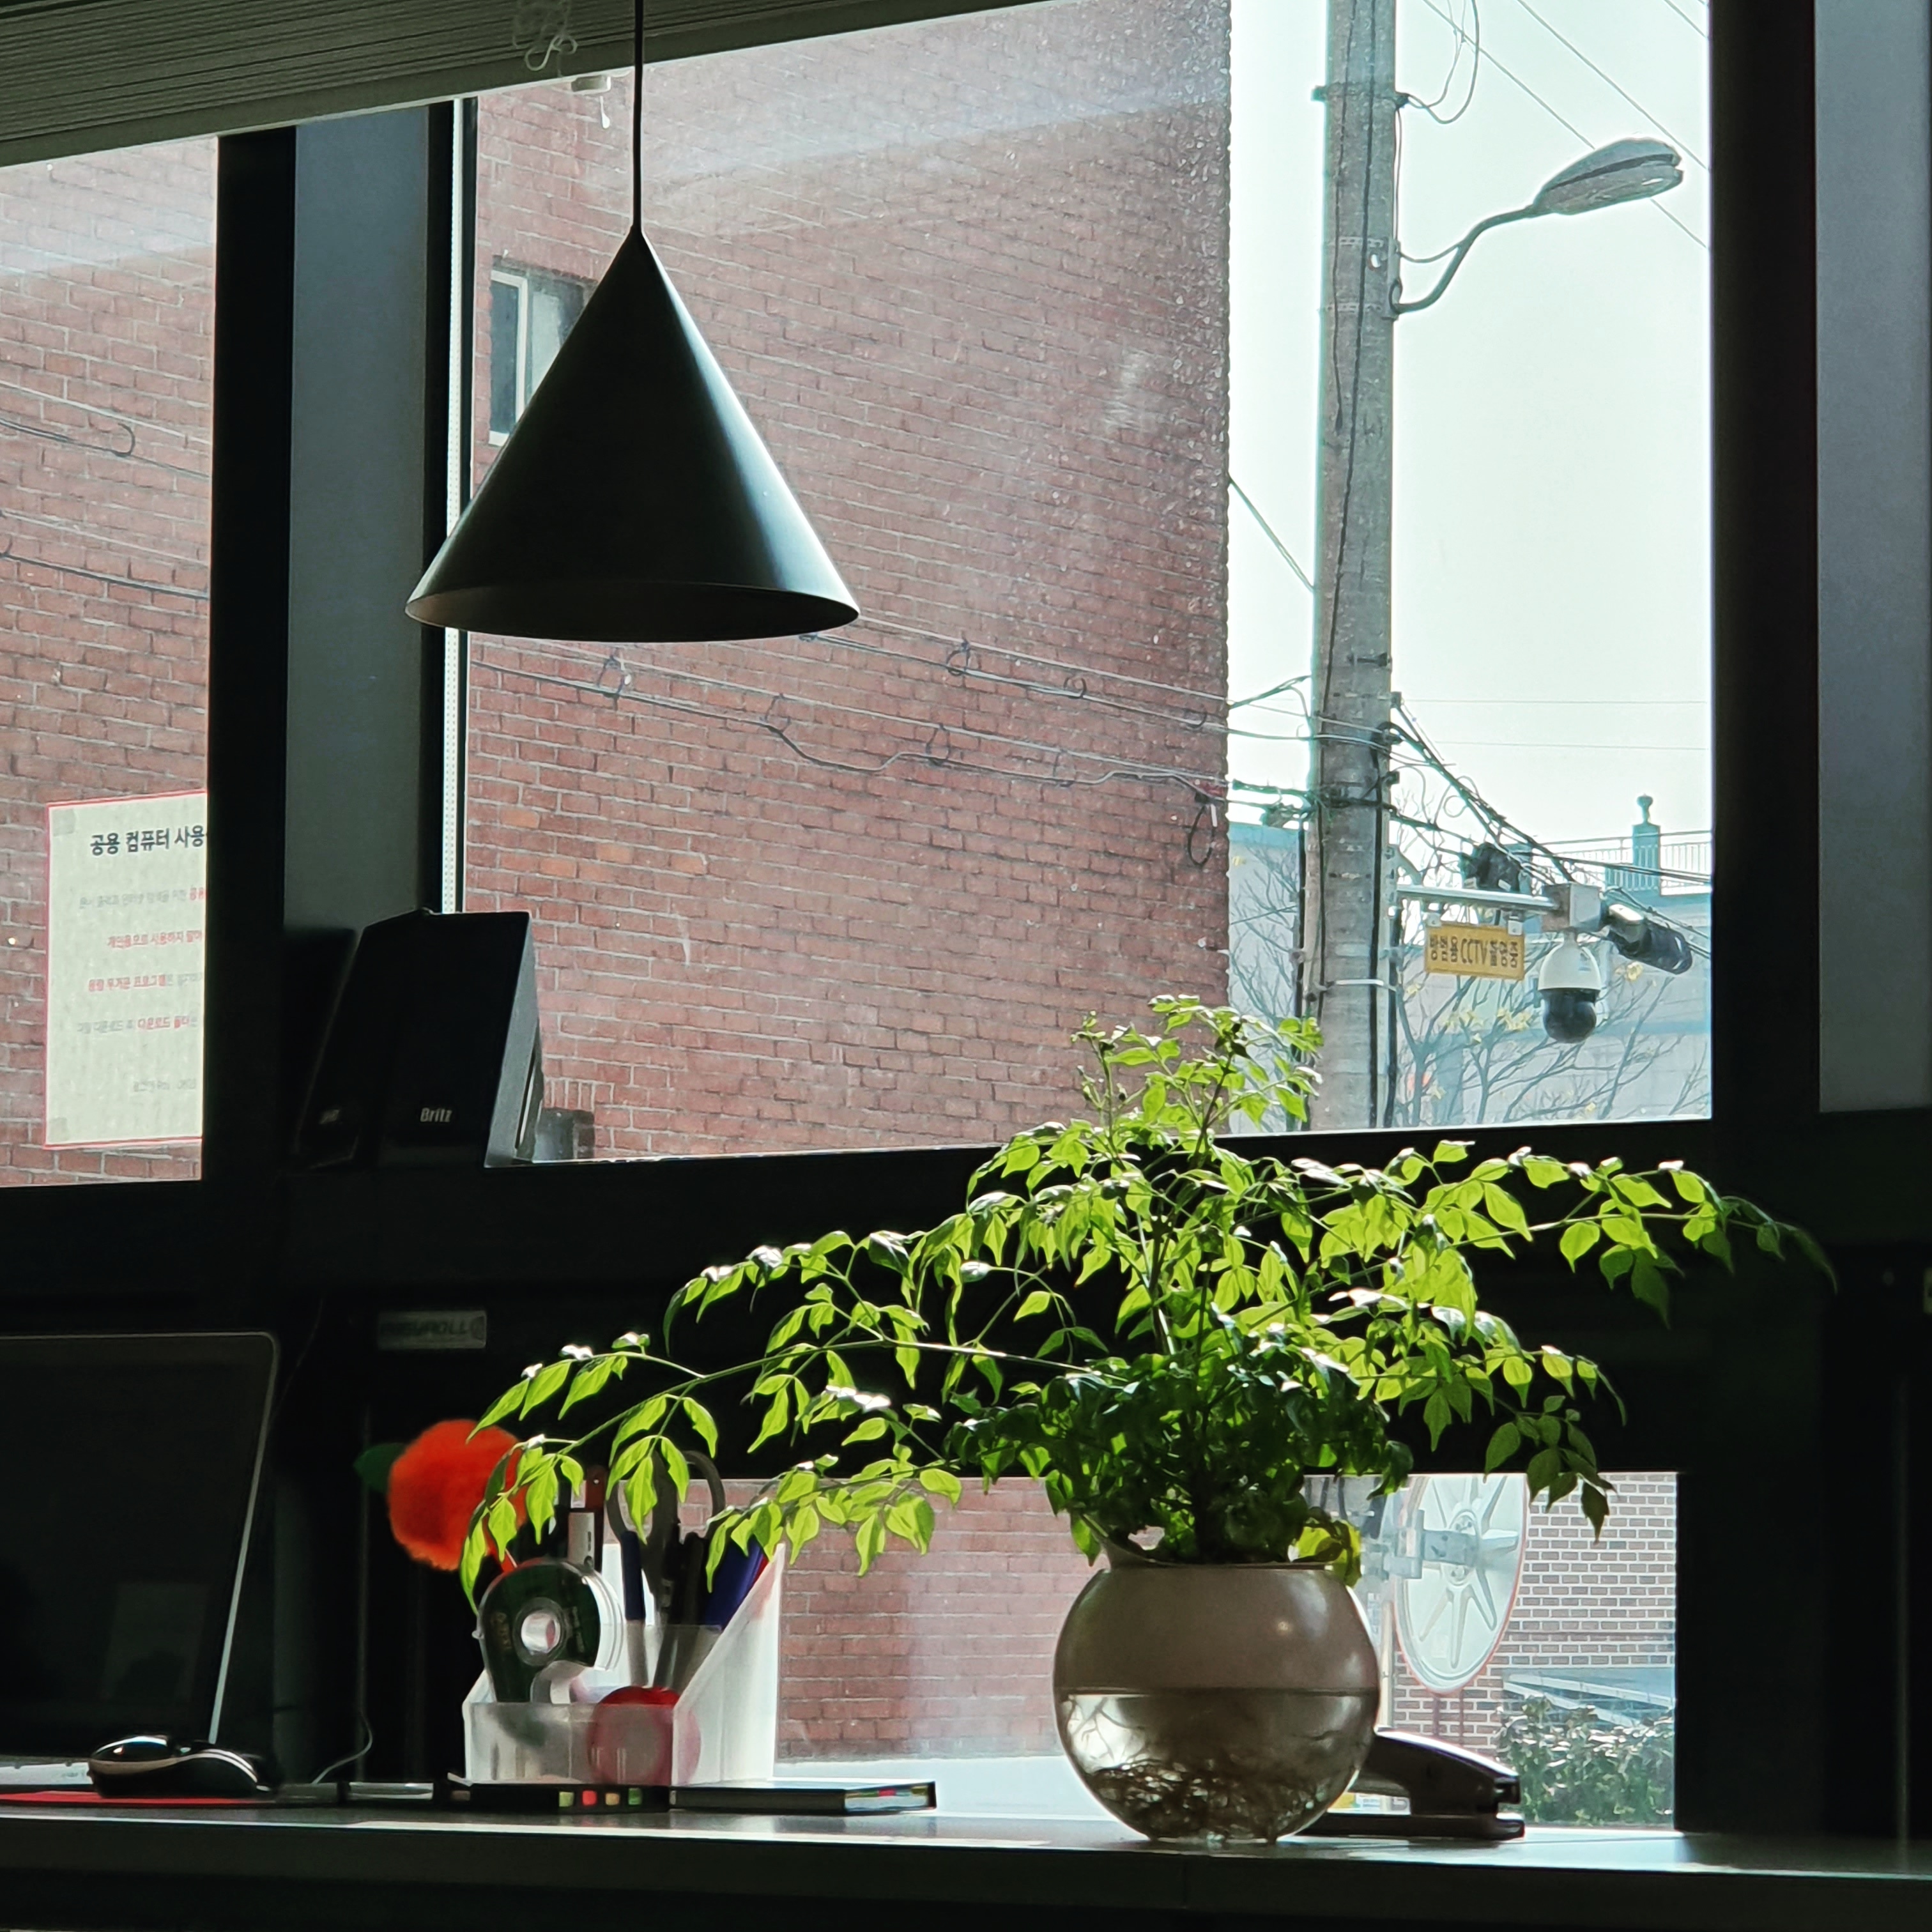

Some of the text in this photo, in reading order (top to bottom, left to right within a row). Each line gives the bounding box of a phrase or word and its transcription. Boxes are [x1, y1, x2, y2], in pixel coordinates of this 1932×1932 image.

[90, 824, 206, 855] 공용 컴퓨터 사용
[420, 1107, 452, 1123] Britz
